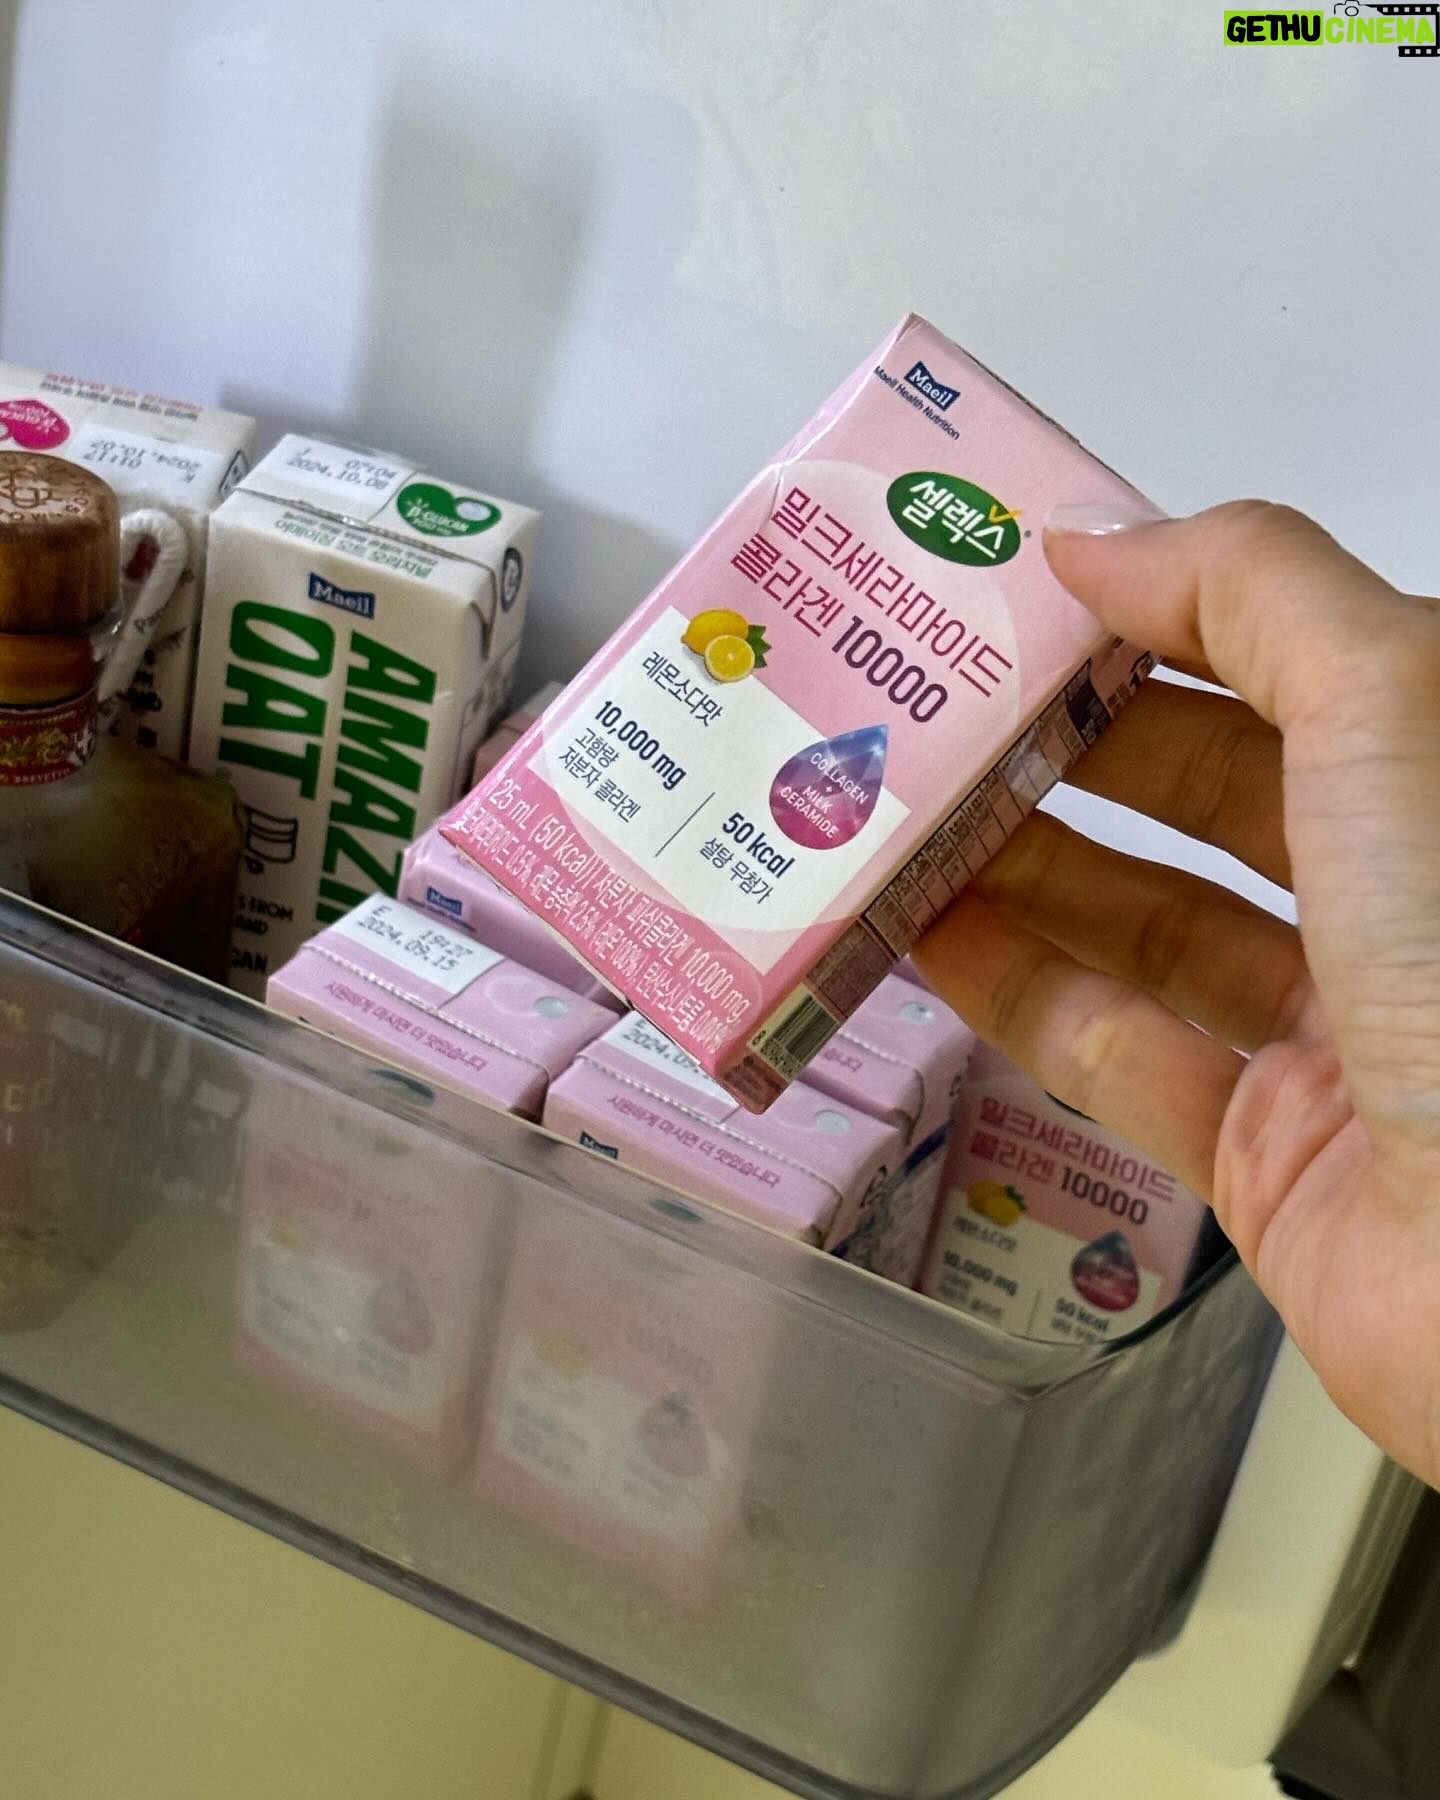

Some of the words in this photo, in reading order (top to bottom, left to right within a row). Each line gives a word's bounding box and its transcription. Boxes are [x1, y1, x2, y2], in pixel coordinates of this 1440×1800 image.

[896, 382, 924, 413] Health
[922, 405, 961, 441] Nutrition
[907, 366, 955, 408] Maeil
[901, 479, 1006, 560] 셀렉스
[311, 579, 372, 616] Maeil
[771, 485, 1014, 699] 밀크세라마이드
[730, 532, 845, 638] 콜라겐
[832, 614, 949, 724] 10000
[218, 599, 336, 801] OAT
[641, 651, 723, 728] 레몬소다맛
[574, 728, 620, 769] 고함량
[594, 700, 661, 761] 10,000
[651, 749, 688, 793] mg
[558, 746, 602, 790] 저분자
[593, 777, 642, 823] 콜라겐
[801, 786, 831, 813] MILK
[809, 752, 868, 805] COLLAGEN
[779, 787, 838, 839] CERAMIDE
[699, 836, 734, 871] 설탕
[730, 861, 777, 905] 무첨가
[722, 812, 755, 845] 50
[748, 832, 796, 880] kcal
[249, 897, 293, 922] FROM
[483, 773, 522, 811] 125
[506, 794, 542, 830] mL
[526, 811, 569, 855] (50
[590, 868, 640, 919] 저분자
[620, 894, 696, 968] 피쉬콜라겐
[677, 944, 736, 1004] 10,000
[356, 920, 460, 973] 2024.09.15
[371, 904, 392, 917] E
[419, 929, 474, 958] 19:27
[409, 1022, 427, 1042] 더
[699, 1138, 718, 1156] 더
[979, 1096, 1177, 1203] 밀크세라마이드
[1060, 1165, 1150, 1226] 10000
